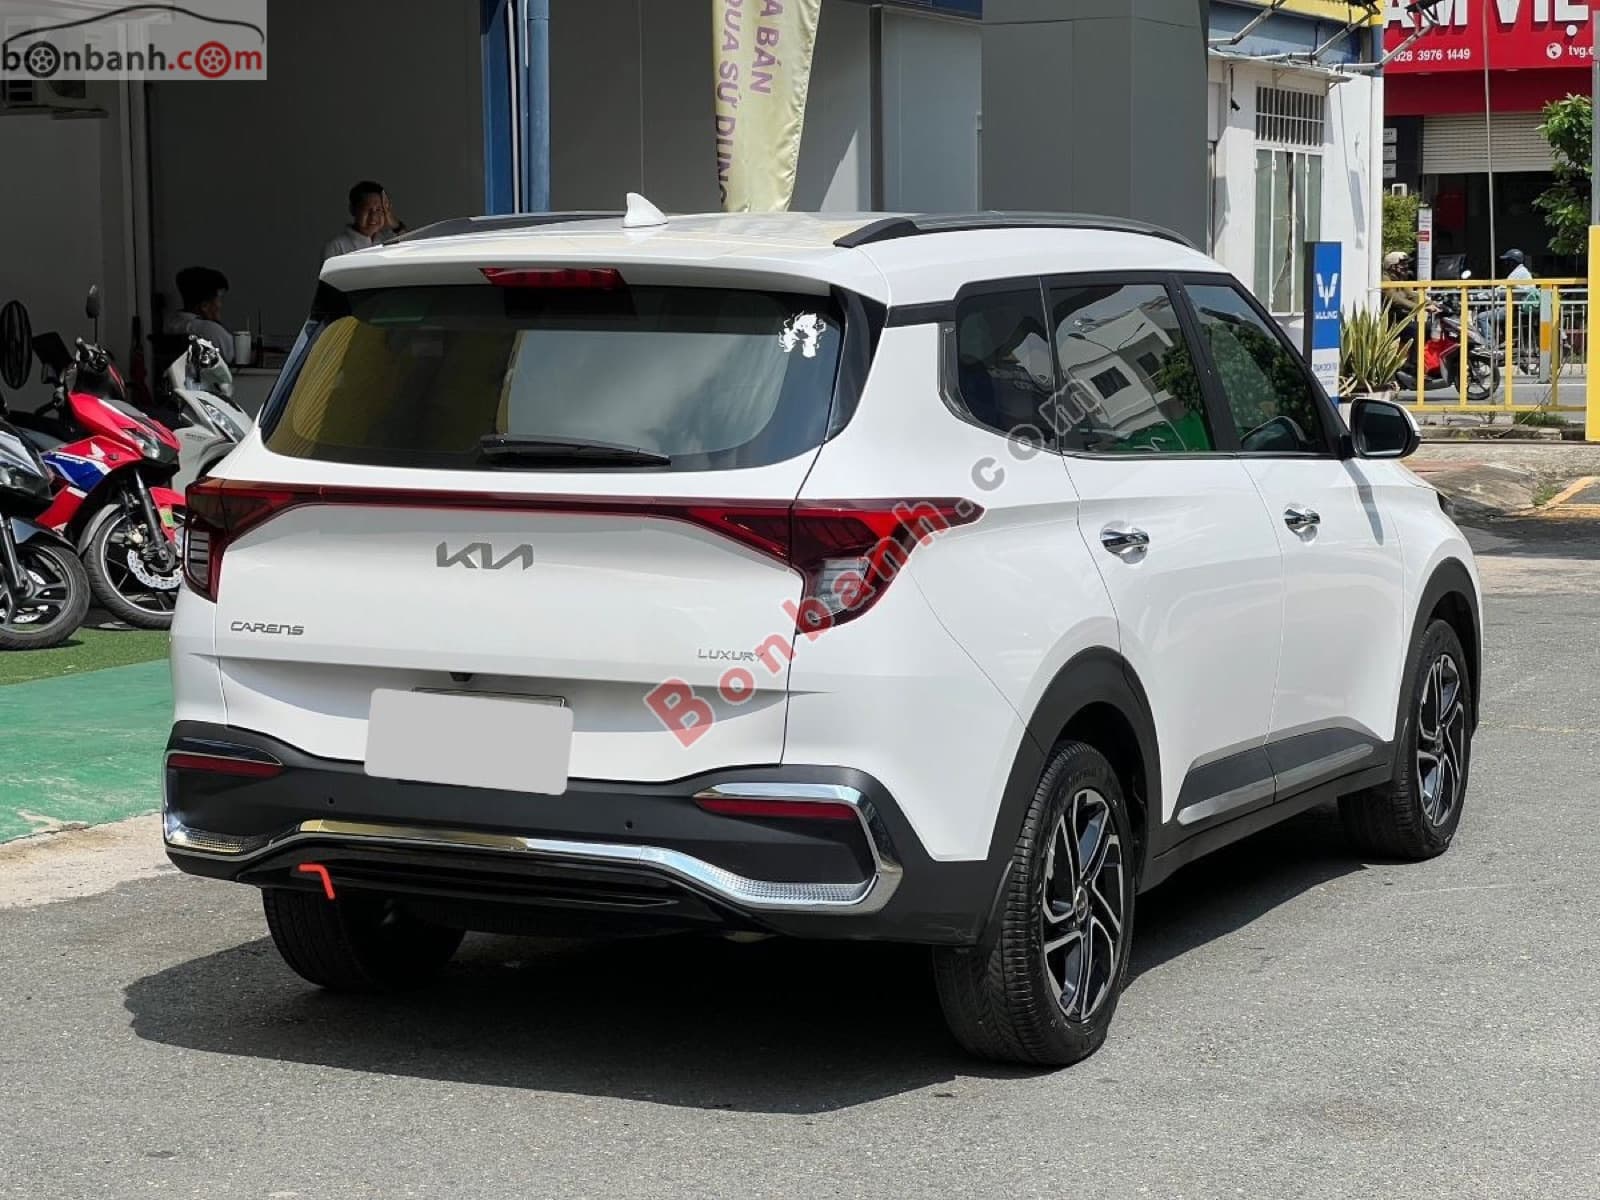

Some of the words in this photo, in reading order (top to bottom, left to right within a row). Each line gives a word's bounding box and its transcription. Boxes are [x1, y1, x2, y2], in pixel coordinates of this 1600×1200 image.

[751, 26, 782, 94] BÁN
[1417, 49, 1442, 61] 3976
[1447, 48, 1470, 60] 1449
[436, 541, 534, 571] KIA
[230, 620, 305, 636] CARENS
